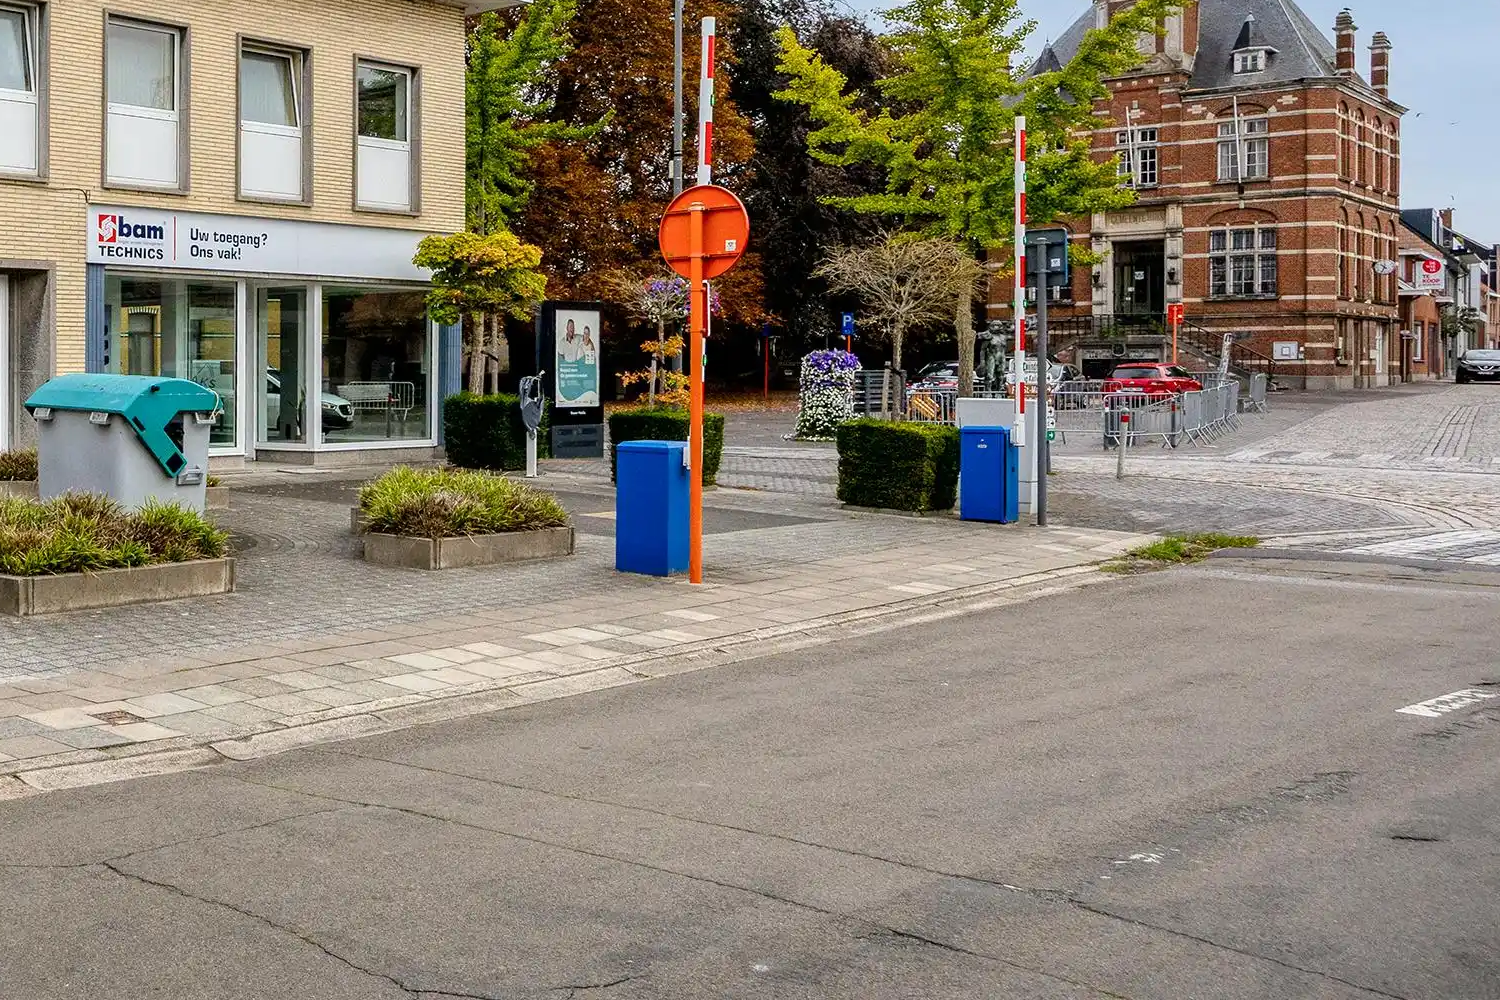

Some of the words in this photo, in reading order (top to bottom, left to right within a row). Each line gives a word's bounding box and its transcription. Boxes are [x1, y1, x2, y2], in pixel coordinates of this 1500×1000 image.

[118, 215, 164, 240] bam
[190, 228, 209, 241] Uw
[213, 231, 268, 248] toegang?
[98, 245, 164, 260] TECHNICS
[190, 245, 214, 258] Ons
[217, 247, 242, 260] vak!
[843, 315, 852, 327] P
